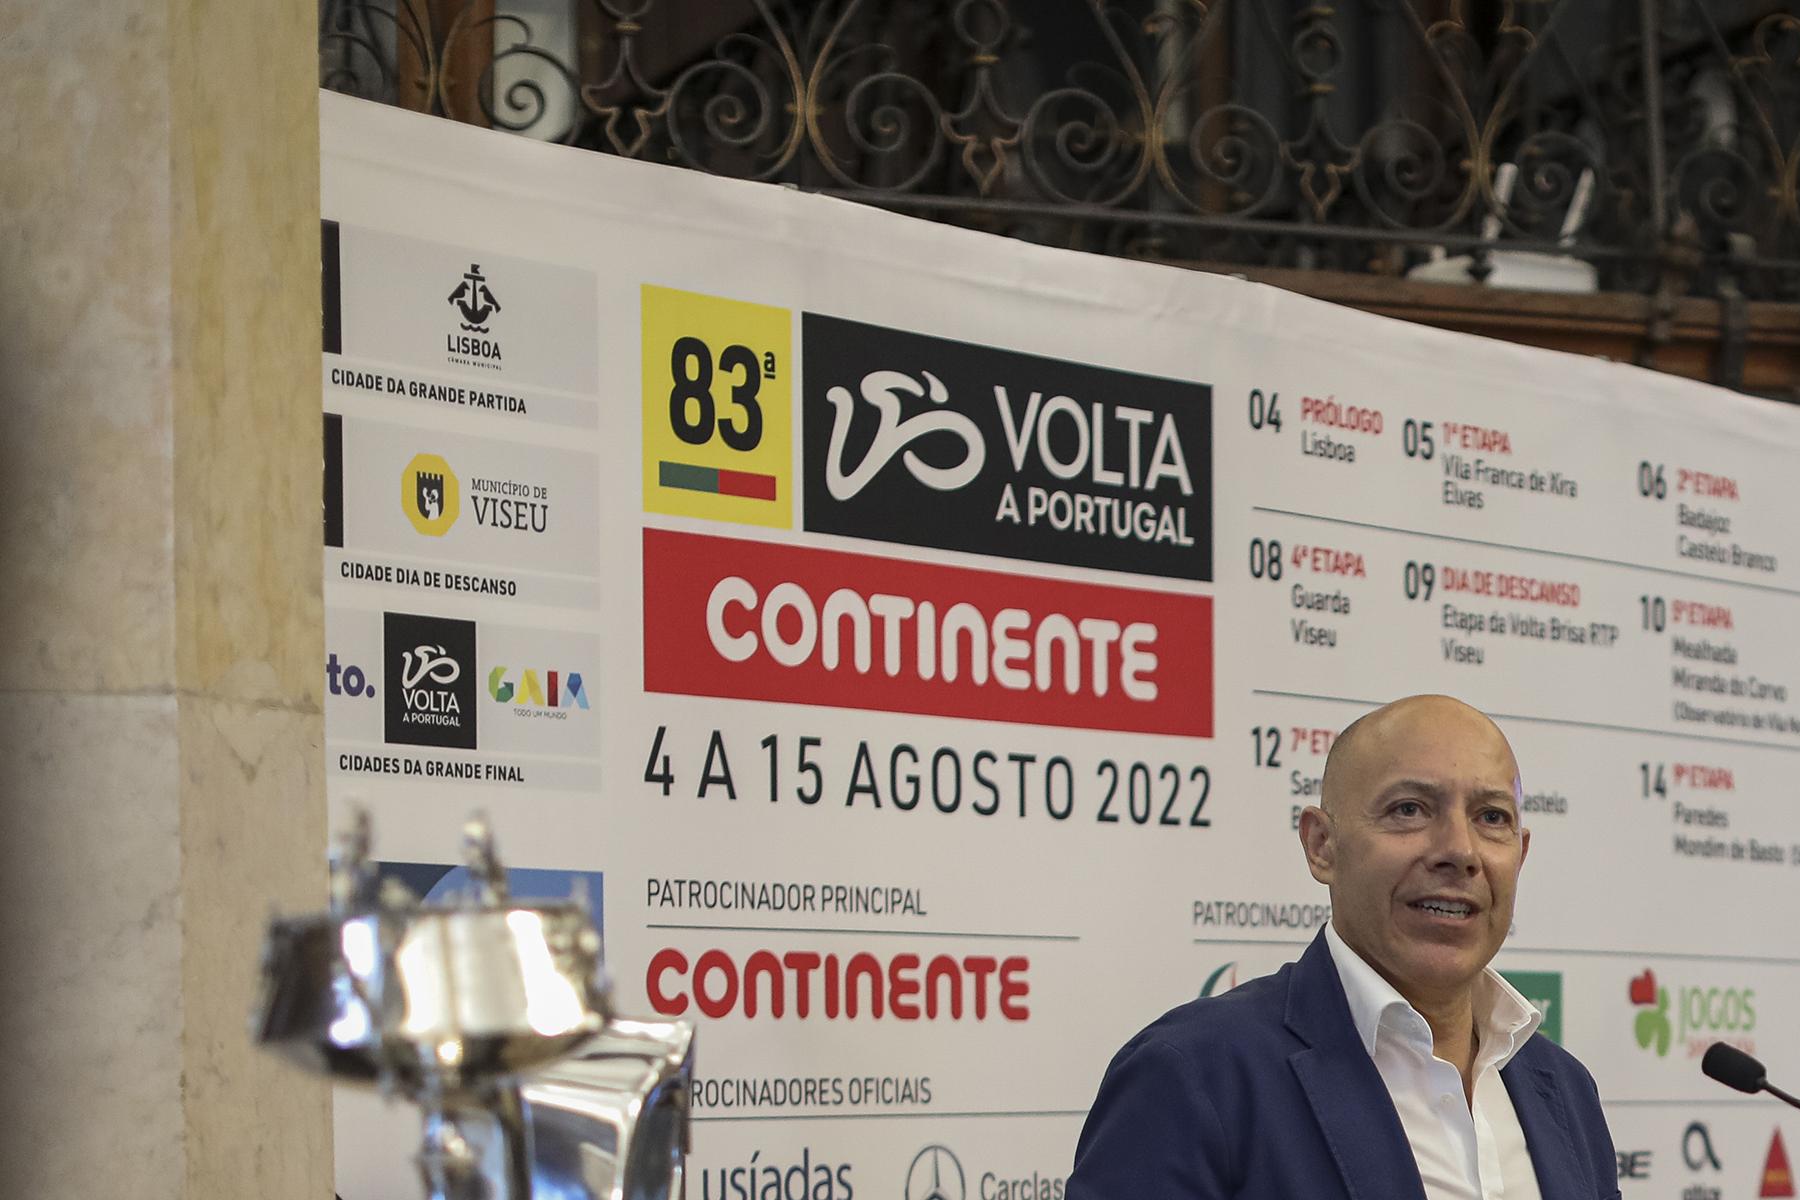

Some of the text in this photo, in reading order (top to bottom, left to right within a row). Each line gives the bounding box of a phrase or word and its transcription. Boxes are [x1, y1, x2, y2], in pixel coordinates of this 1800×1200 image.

[447, 334, 502, 360] LISBOA
[331, 368, 527, 414] CIDADE DA GRANDE PARTIDA
[669, 336, 777, 452] 83ª
[1249, 389, 1282, 433] 04
[1301, 396, 1383, 435] PRÓLOGO
[994, 385, 1194, 496] VOLTA
[1301, 431, 1356, 463] Lisboa
[1403, 418, 1435, 460] 05
[471, 477, 547, 499] MUNICÍPIO DE
[1442, 454, 1578, 498] Vila Franca de Xira
[1638, 460, 1667, 499] 06
[471, 495, 549, 533] VISEU
[1442, 481, 1485, 510] Elvas
[996, 484, 1195, 547] A PORTUGAL
[1249, 537, 1283, 581] 08
[341, 561, 517, 596] CIDADE DIA DE DESCANSO
[1404, 561, 1435, 601] 09
[1442, 566, 1580, 607] DIA DE DESCANSO
[1291, 583, 1351, 615] Guarda
[1639, 595, 1667, 633] 10
[706, 576, 1158, 702] CONTINENTE
[1291, 618, 1337, 647] Viseu
[1442, 604, 1485, 637] Etapa
[1509, 614, 1546, 640] Volta
[1550, 617, 1586, 645] Brisa
[1442, 638, 1485, 664] Viseu
[402, 689, 460, 713] VOLTA
[488, 666, 590, 710] GAIA
[402, 713, 461, 728] A PORTUGAL
[1250, 727, 1282, 768] 12
[1310, 728, 1338, 755] ET
[339, 754, 525, 783] CIDADES DA GRANDE FINAL
[643, 726, 1212, 827] 4 A 15 AGOSTO 2022
[1640, 762, 1668, 799] 14
[1522, 794, 1569, 815] astelo
[646, 879, 928, 916] PATROCINADOR PRINCIPAL
[646, 948, 1030, 1021] CONTINENTE
[848, 1076, 932, 1106] OFICIAIS
